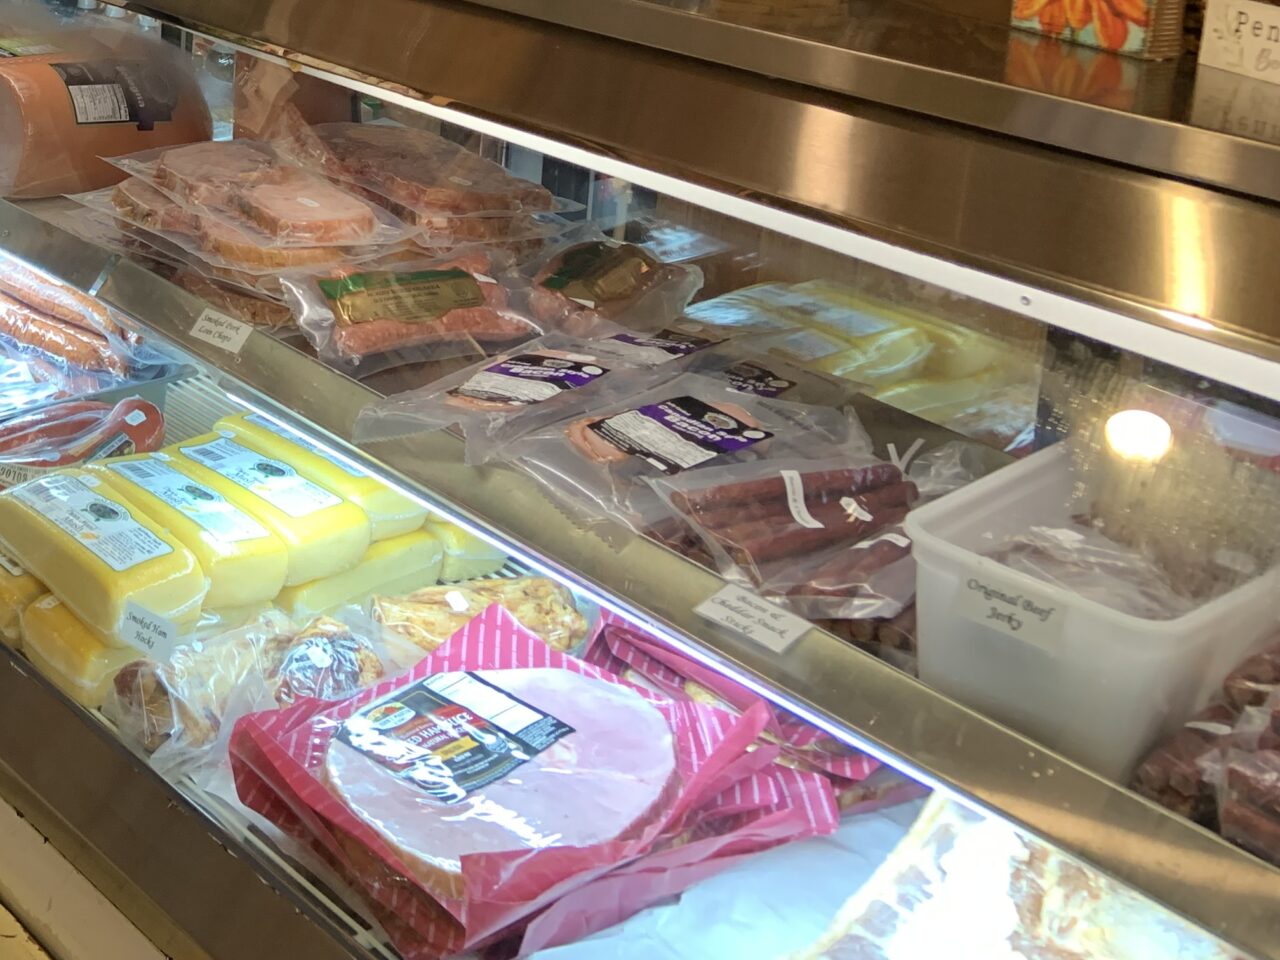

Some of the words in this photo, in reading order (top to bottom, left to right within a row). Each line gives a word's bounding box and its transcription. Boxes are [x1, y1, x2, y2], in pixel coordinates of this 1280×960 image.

[663, 415, 723, 442] Bacon
[737, 595, 768, 613] Bacon
[967, 578, 1023, 607] Original
[1022, 599, 1056, 622] Beef
[127, 611, 154, 630] Smoked
[151, 623, 168, 639] Ham
[986, 606, 1024, 631] Jerky
[134, 630, 155, 650] Hocks
